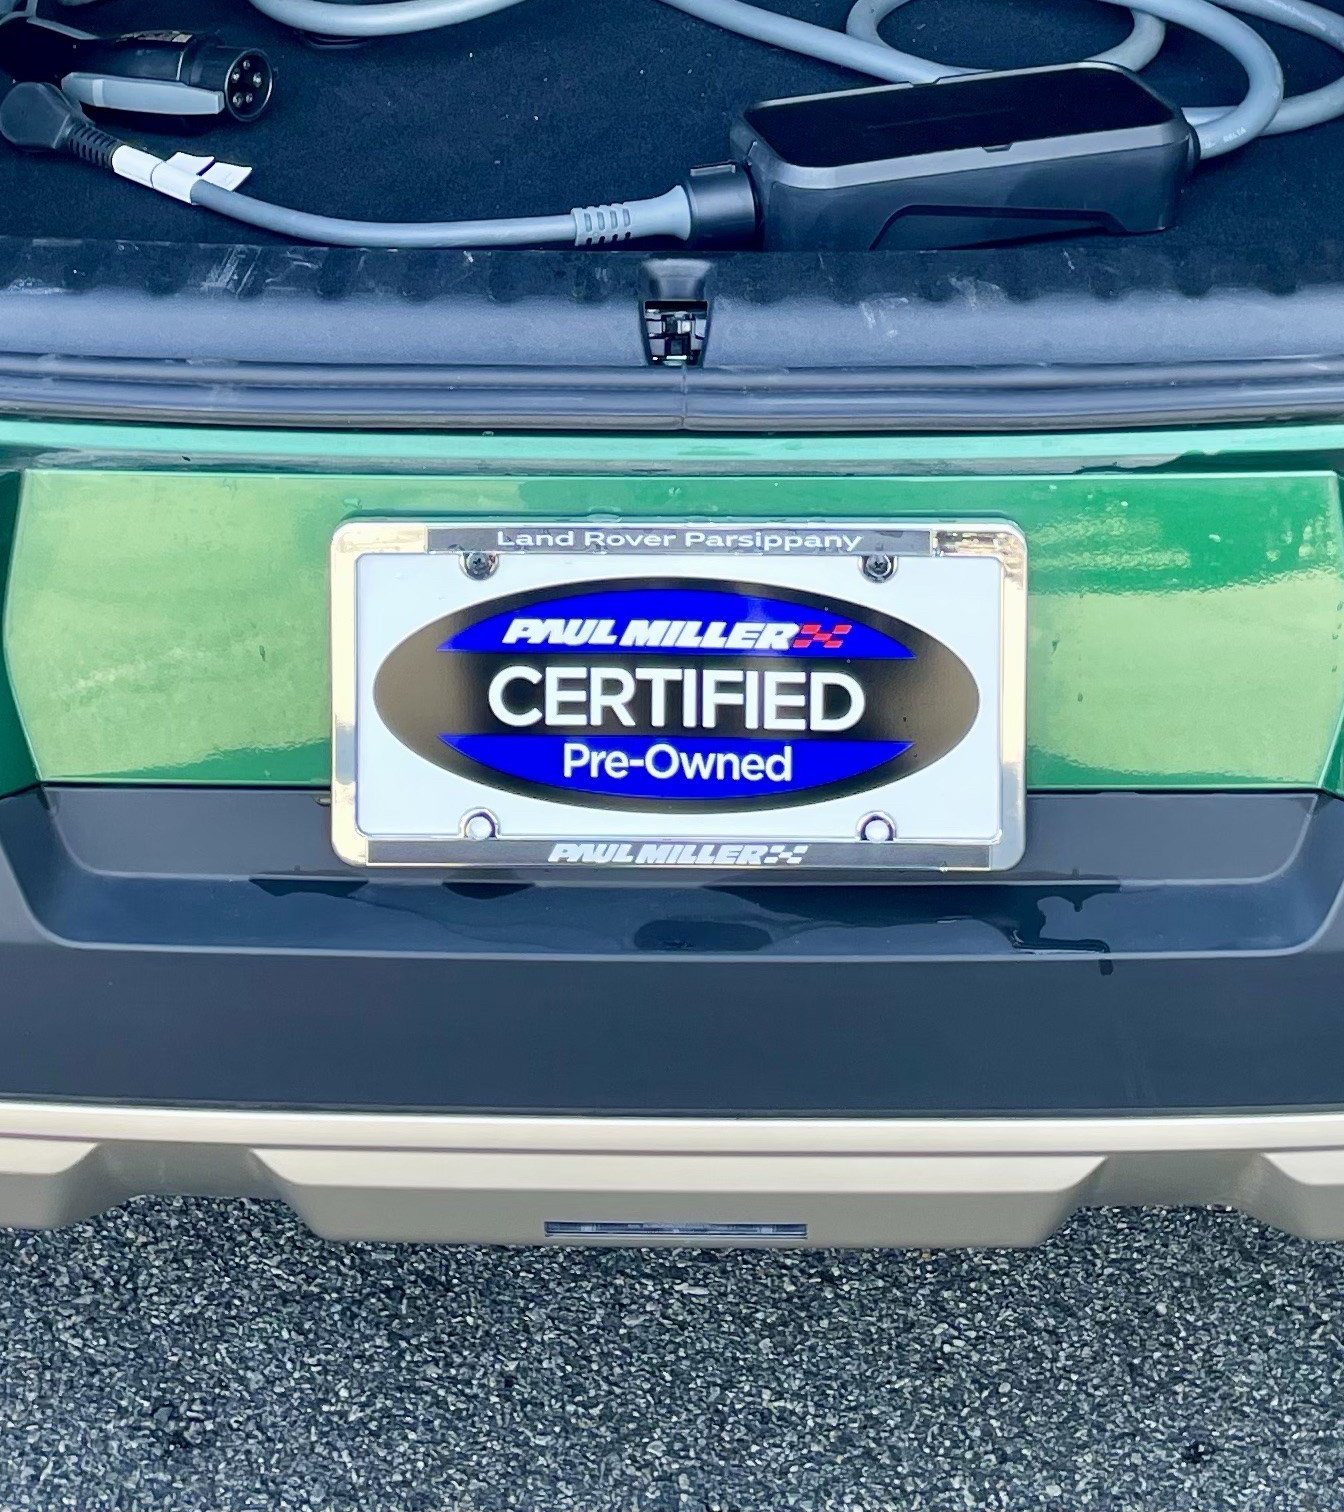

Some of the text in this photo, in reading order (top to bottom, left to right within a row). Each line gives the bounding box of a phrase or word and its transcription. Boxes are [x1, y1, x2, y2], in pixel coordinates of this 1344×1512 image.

[497, 530, 863, 552] Land Rover Parsippany
[502, 618, 800, 650] PAUL MILLER
[488, 665, 865, 732] CERTIFIED
[563, 742, 792, 781] Pre-Owned
[548, 843, 768, 865] PAUL MILLER
